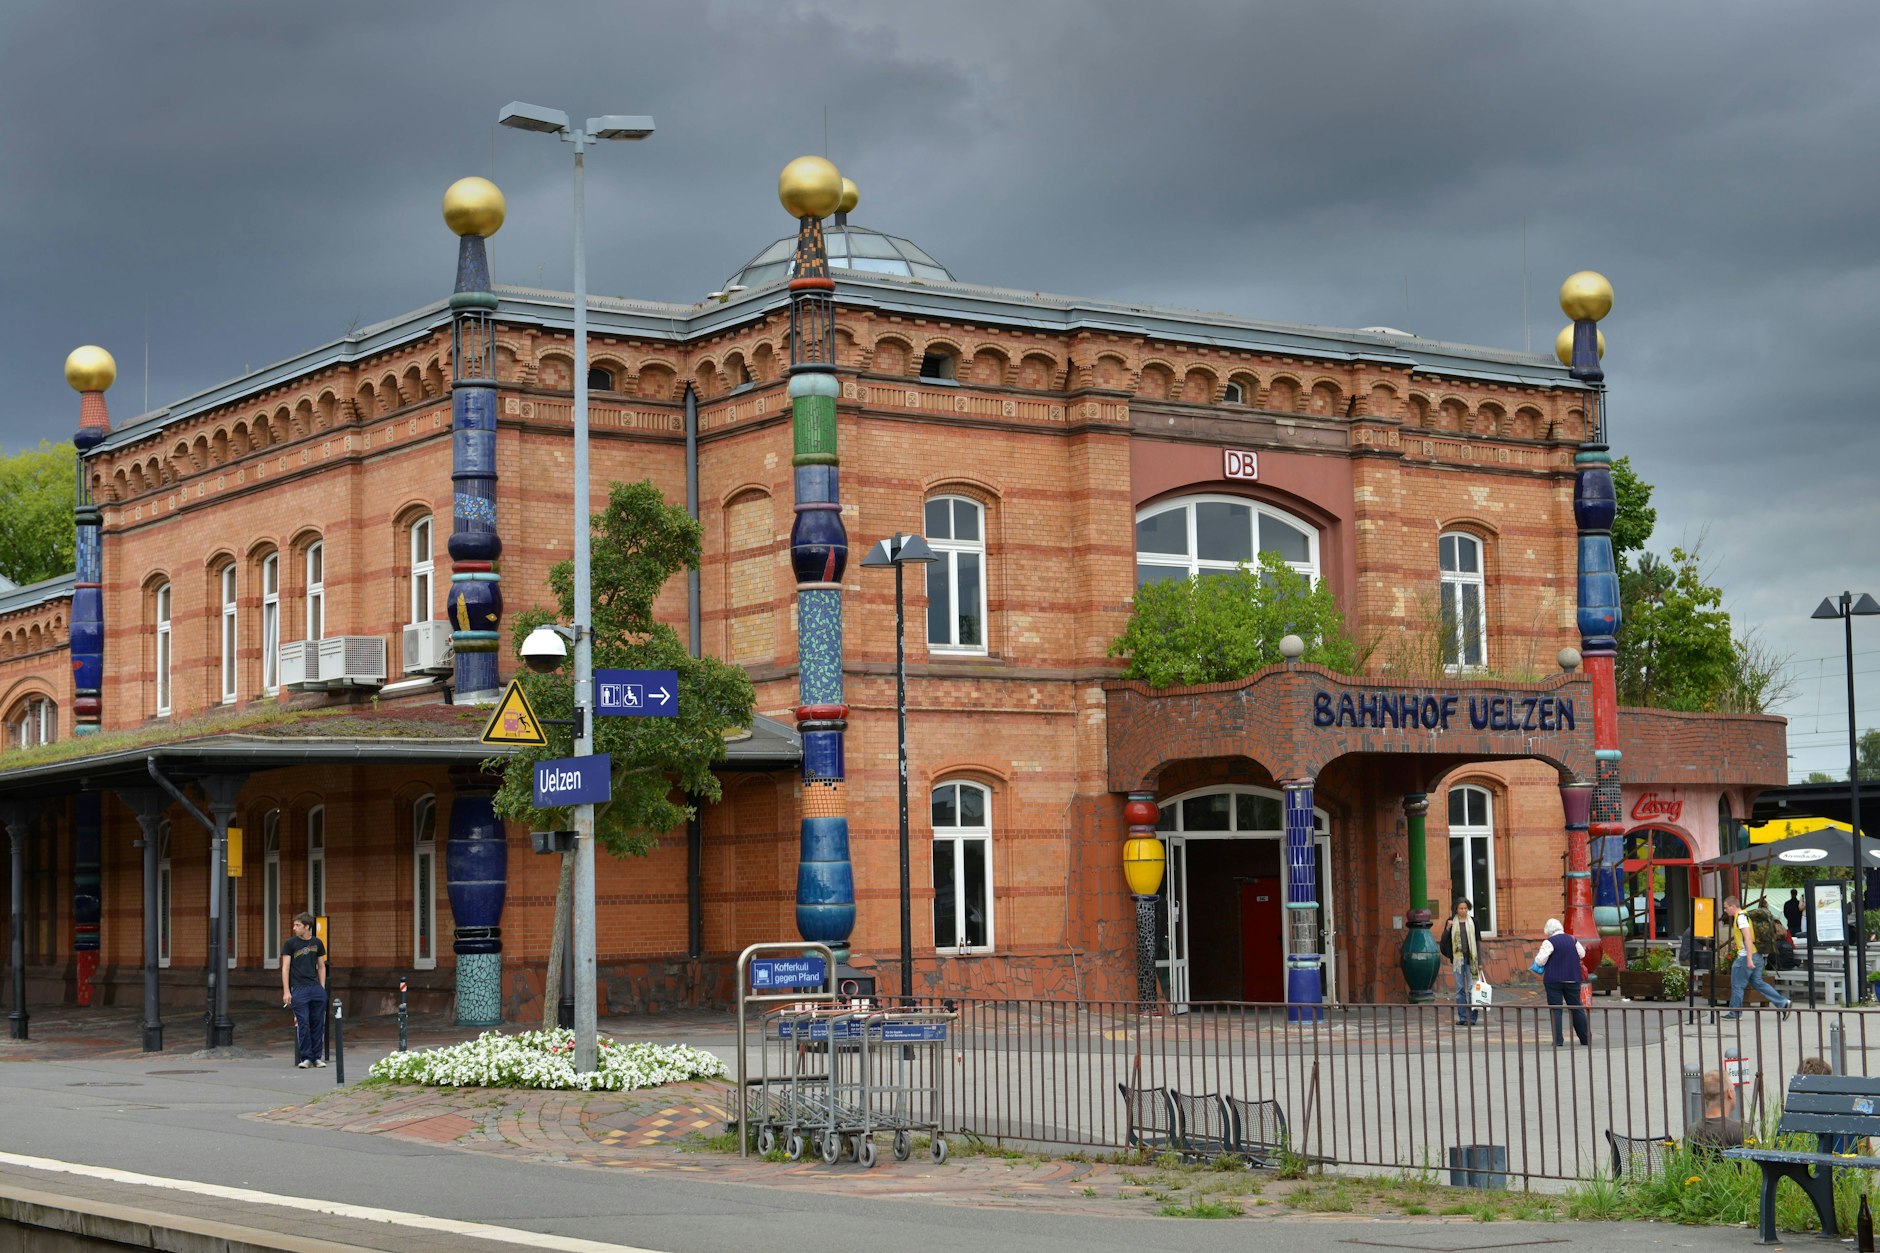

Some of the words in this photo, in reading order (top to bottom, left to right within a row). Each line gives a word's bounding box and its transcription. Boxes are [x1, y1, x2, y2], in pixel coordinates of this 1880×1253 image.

[1228, 452, 1255, 476] DB
[1314, 689, 1458, 729] BAHNHOF
[1470, 695, 1576, 731] UELZEN
[540, 768, 582, 793] Uelzen
[774, 962, 809, 972] Kofferkuli
[774, 974, 797, 984] gegen
[798, 972, 820, 982] Pfand
